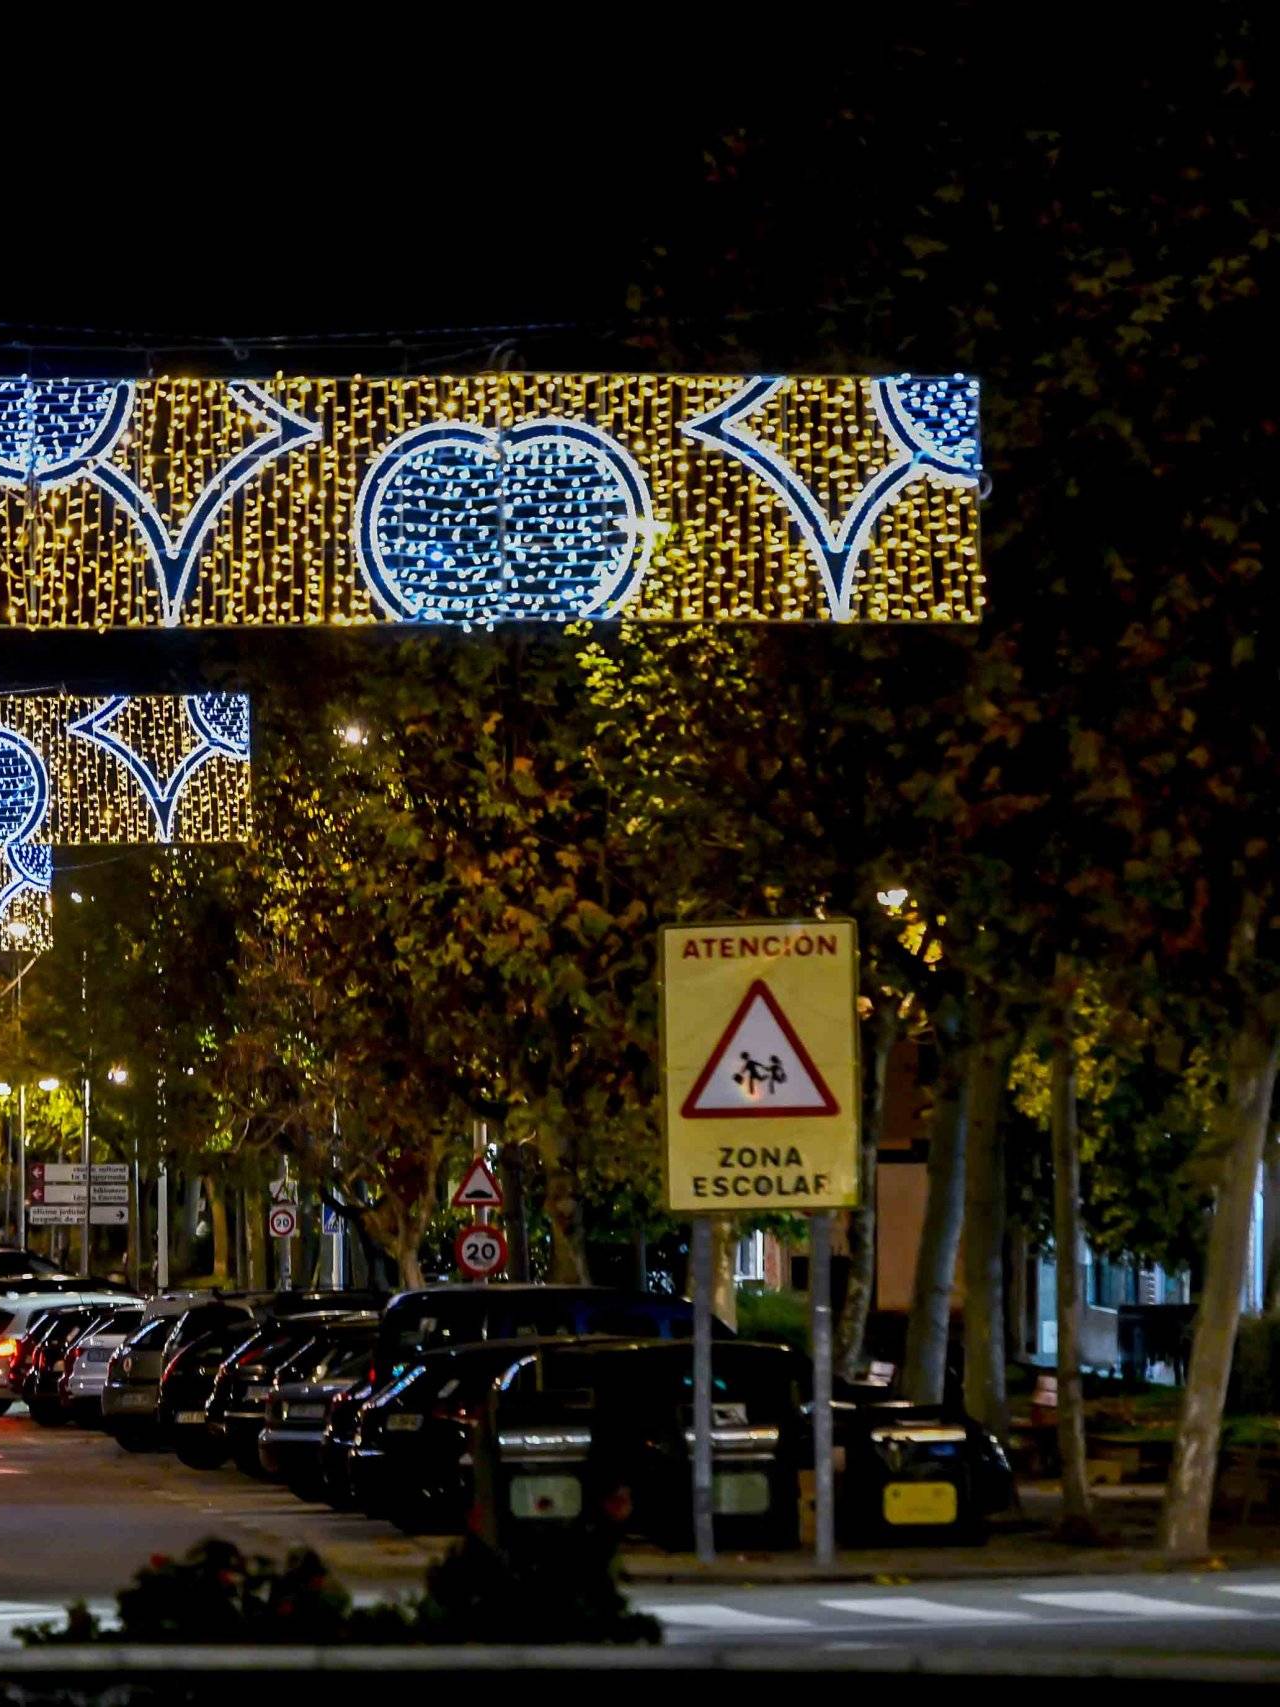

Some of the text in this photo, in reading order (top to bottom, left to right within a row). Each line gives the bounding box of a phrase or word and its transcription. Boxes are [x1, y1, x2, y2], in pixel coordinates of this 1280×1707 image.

[718, 1145, 803, 1168] ZONA
[276, 1217, 290, 1228] 20
[466, 1242, 496, 1261] 20
